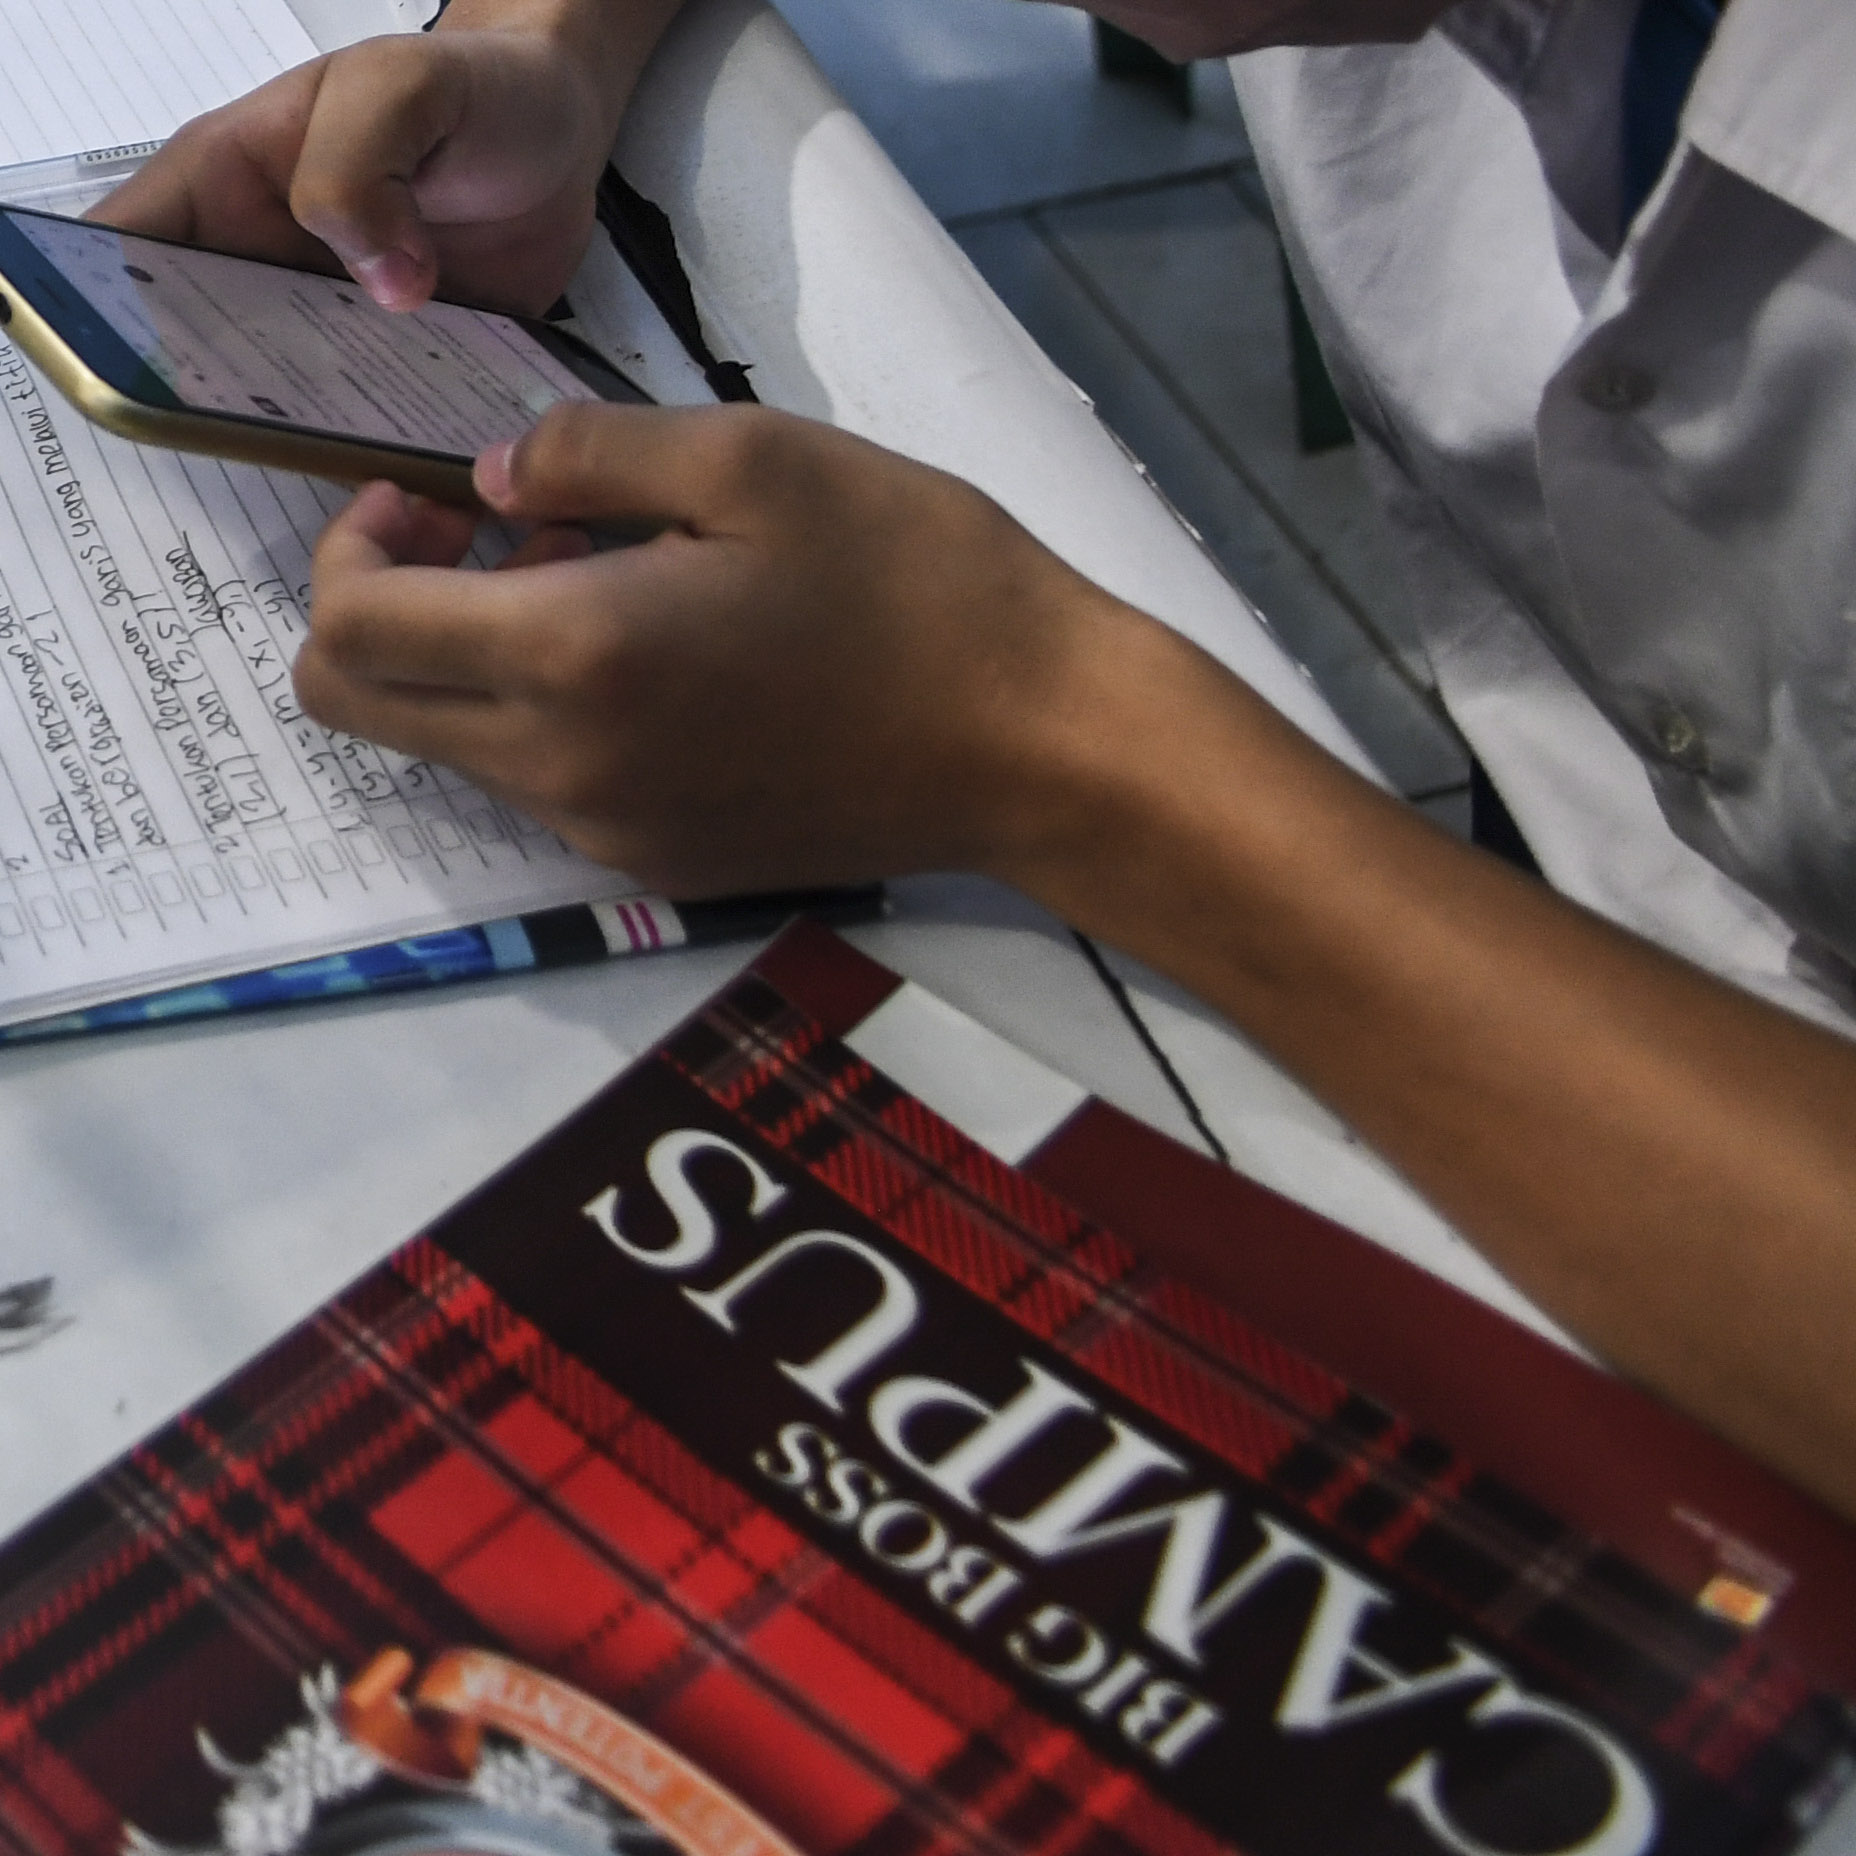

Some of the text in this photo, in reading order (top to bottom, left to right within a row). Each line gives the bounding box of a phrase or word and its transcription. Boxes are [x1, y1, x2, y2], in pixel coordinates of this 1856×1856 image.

[583, 1130, 1655, 1856] CAMPUS
[756, 1423, 1214, 1761] BIG BOSS
